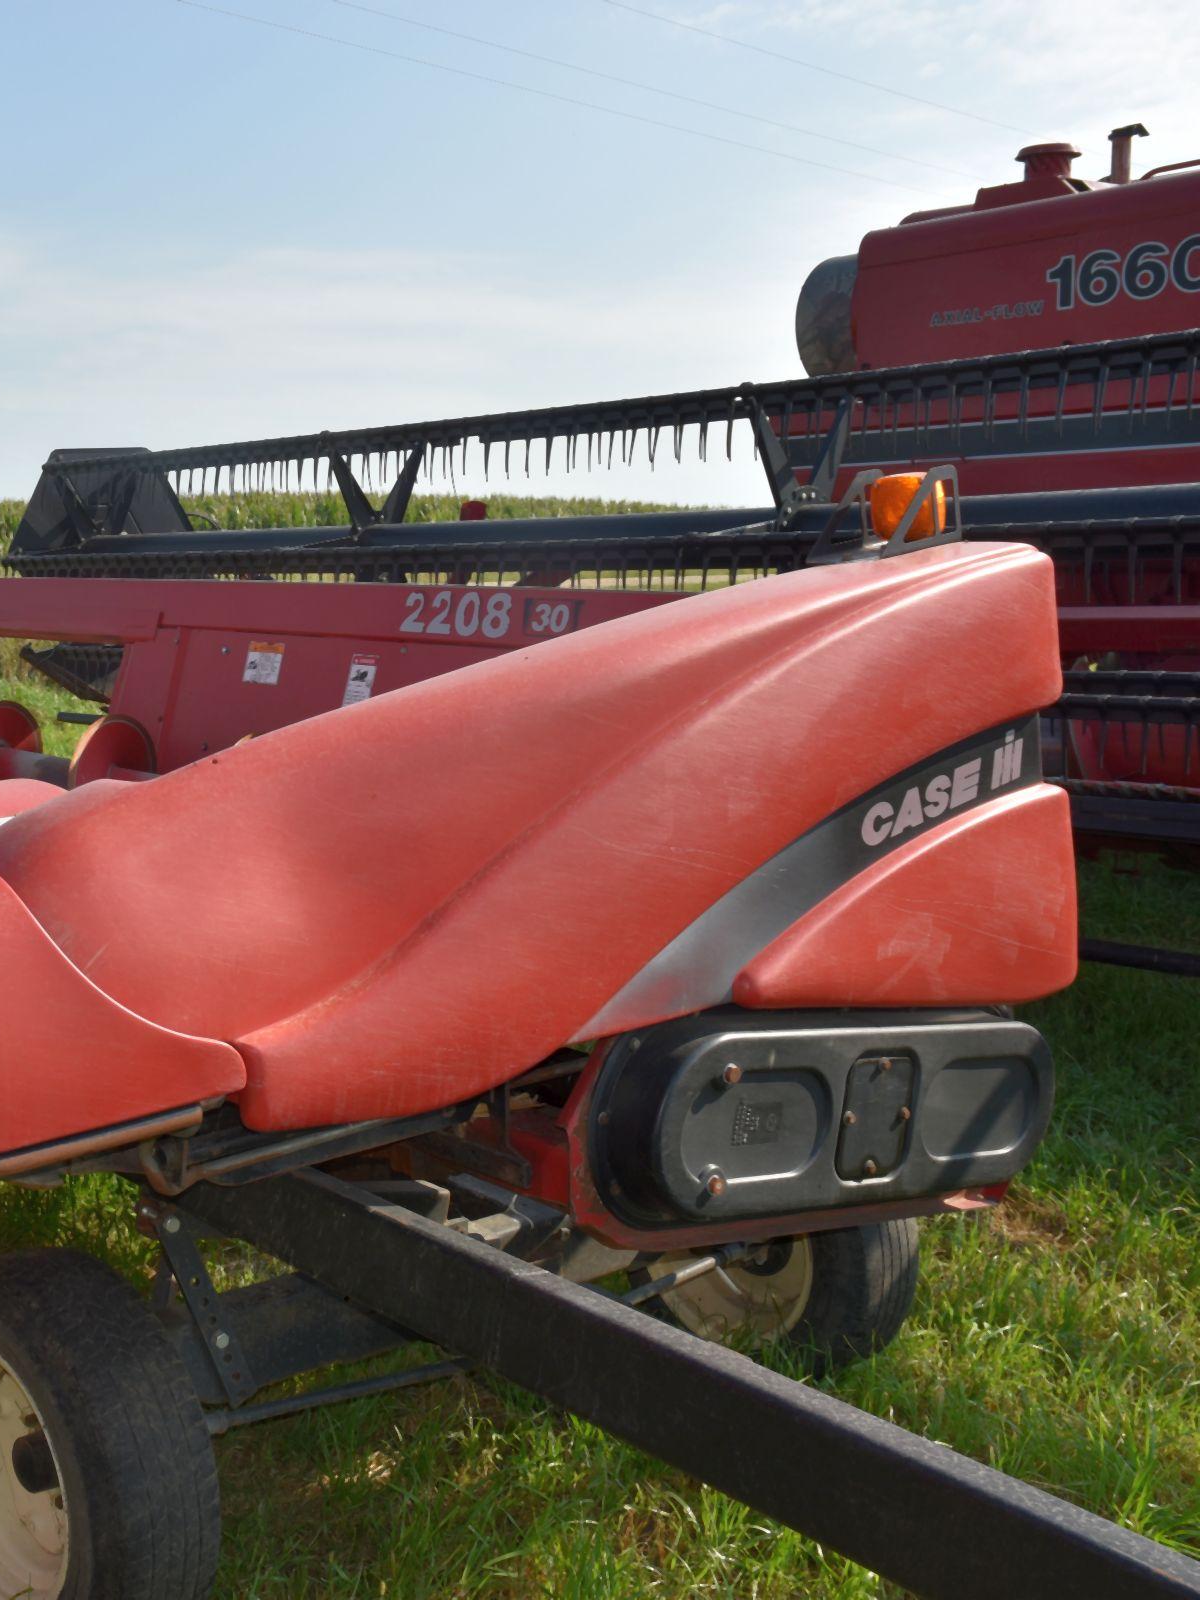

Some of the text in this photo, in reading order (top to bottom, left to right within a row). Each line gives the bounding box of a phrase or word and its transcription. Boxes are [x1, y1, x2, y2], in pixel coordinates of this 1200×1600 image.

[930, 299, 1045, 327] AXIAL-FLOW
[400, 590, 570, 638] 2208 30
[860, 757, 982, 846] CASE
